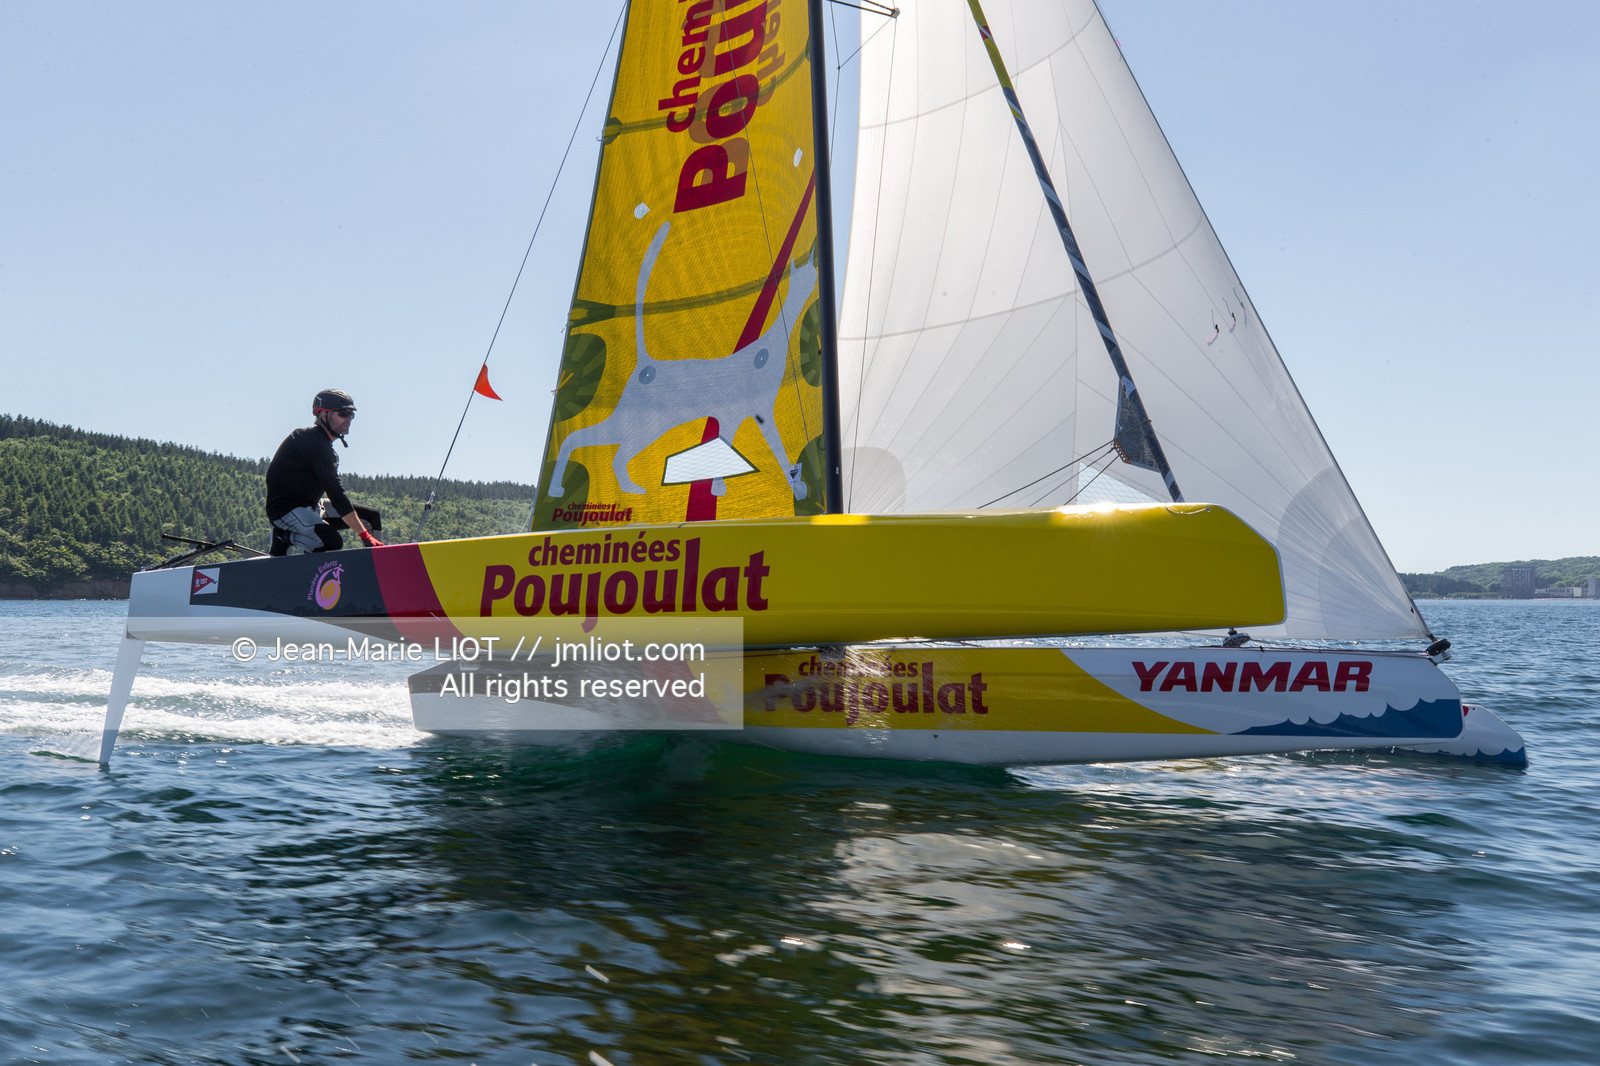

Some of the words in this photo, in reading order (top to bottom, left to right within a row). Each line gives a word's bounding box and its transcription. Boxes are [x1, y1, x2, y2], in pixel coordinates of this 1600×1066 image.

[658, 0, 714, 133] chem
[673, 0, 768, 214] Pou
[552, 503, 633, 527] Poujoulat
[528, 531, 681, 567] cheminées
[480, 537, 770, 634] Poujoulat
[798, 655, 919, 678] chemnées
[1131, 661, 1373, 692] YANMAR
[764, 661, 989, 727] Poujoulat
